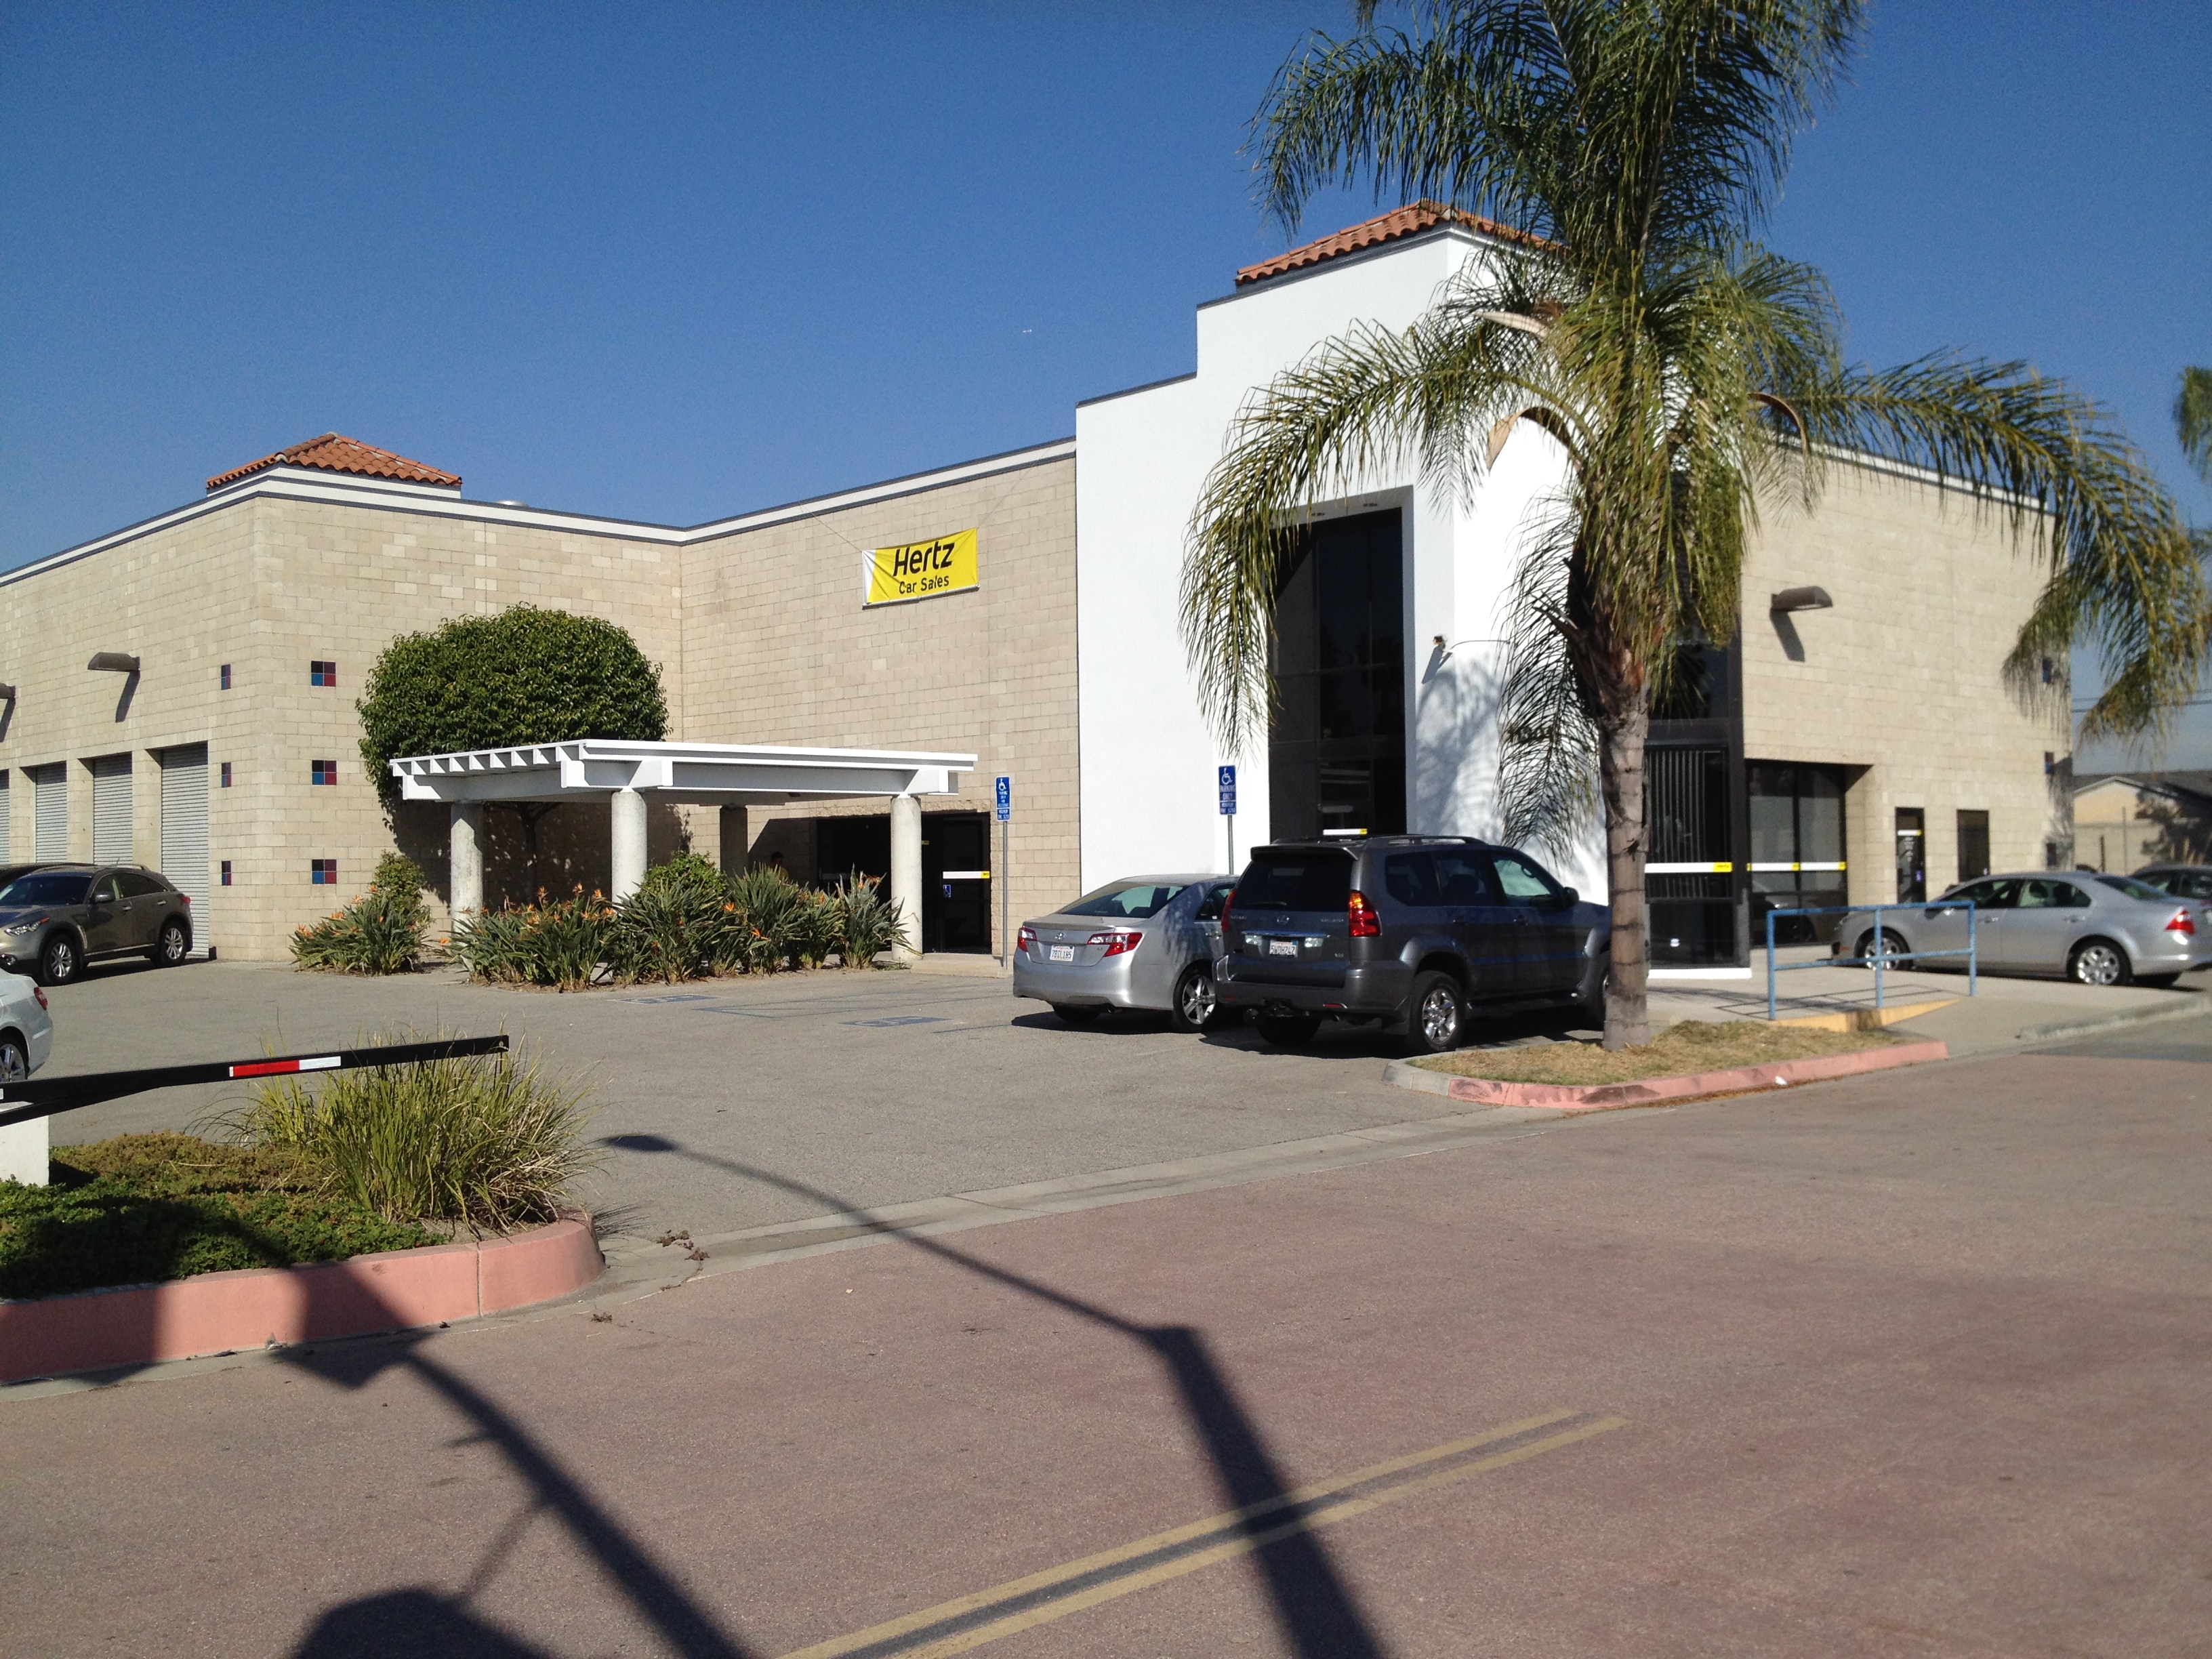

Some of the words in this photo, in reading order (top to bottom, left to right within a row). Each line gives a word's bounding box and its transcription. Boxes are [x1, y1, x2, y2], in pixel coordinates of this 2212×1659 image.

[893, 541, 956, 577] Hertz
[899, 581, 918, 594] Car
[920, 575, 949, 591] Sales
